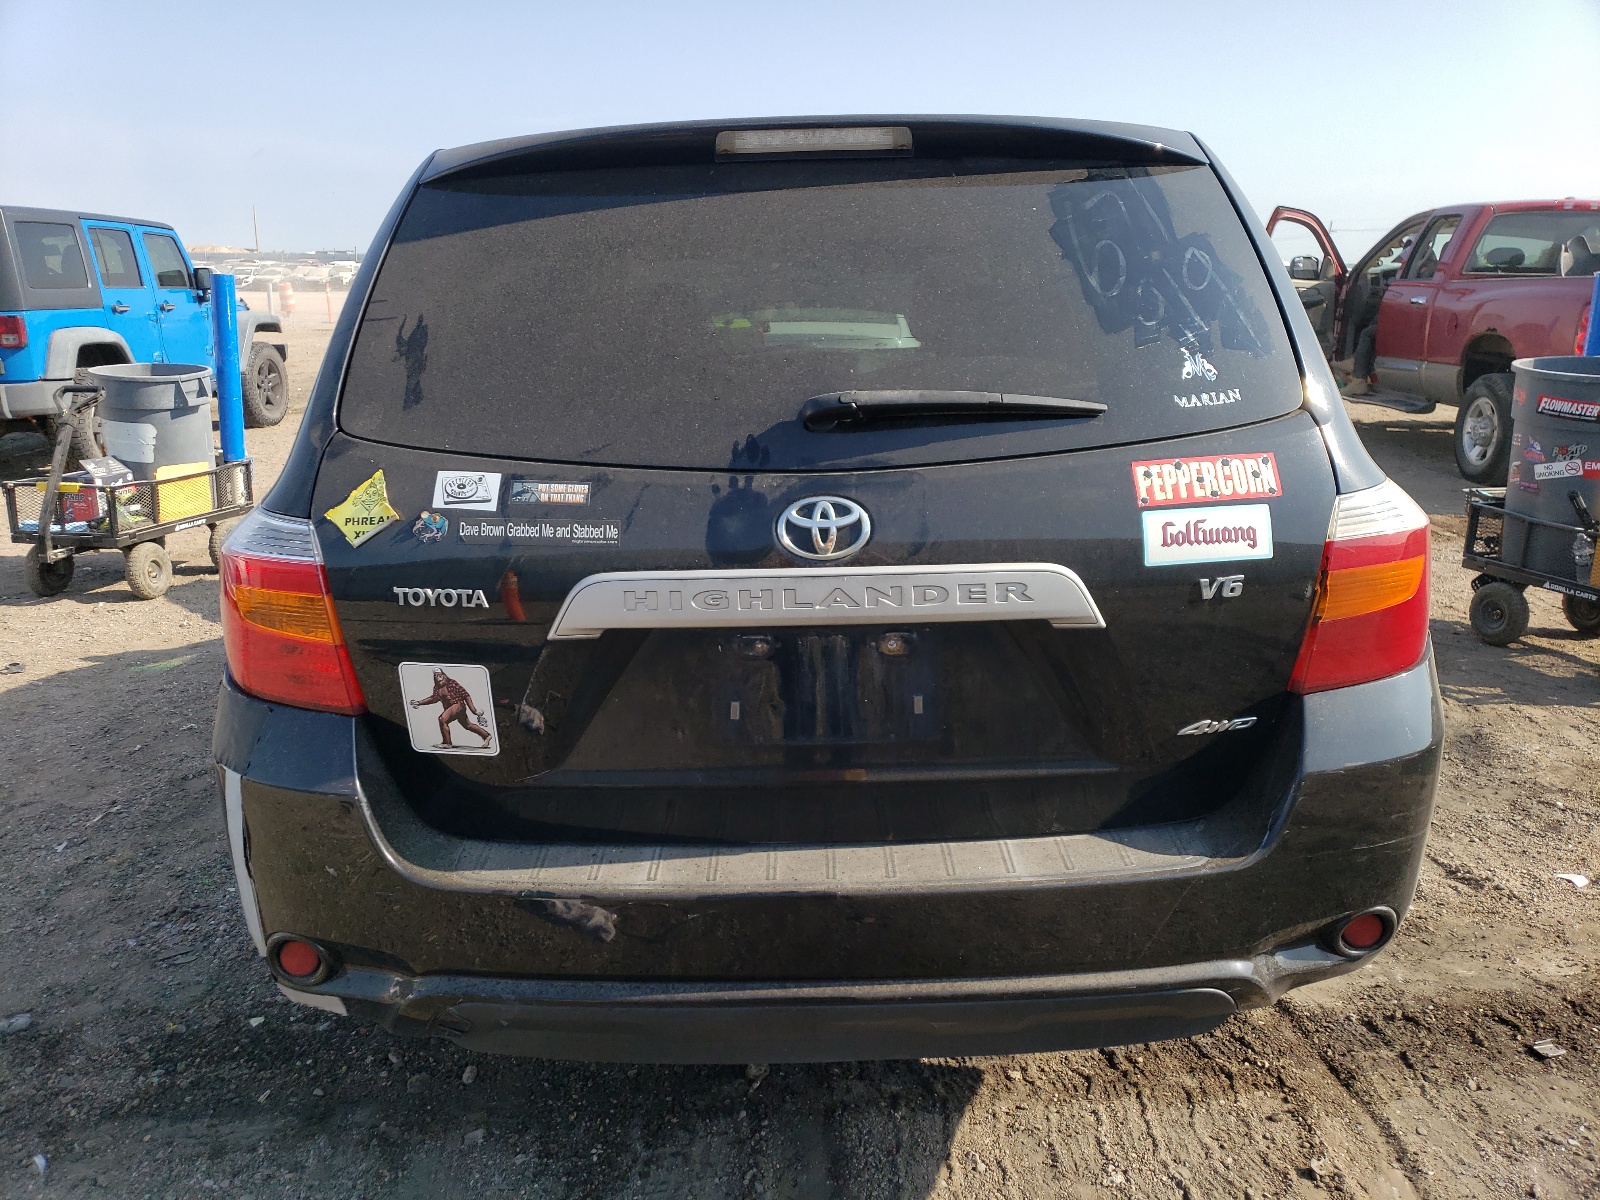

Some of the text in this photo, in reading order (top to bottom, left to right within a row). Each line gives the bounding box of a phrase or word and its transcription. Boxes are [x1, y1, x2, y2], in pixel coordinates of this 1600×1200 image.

[1174, 389, 1241, 408] MARIAN
[1538, 397, 1600, 417] FLOWMASTER
[1135, 456, 1277, 504] PEPPERCORN
[1536, 470, 1565, 478] SMOKING
[538, 483, 589, 494] PUT SOME GLOVES
[540, 493, 549, 503] ON
[550, 493, 565, 503] THAT
[460, 522, 619, 539] Dave Brown Grabbed Me and Stabbed Me
[623, 581, 1035, 612] HIGHLANDER
[1200, 575, 1245, 600] V6
[1551, 584, 1574, 595] GORILLA
[393, 587, 489, 608] TOYOTA
[1177, 716, 1258, 736] 4WD
